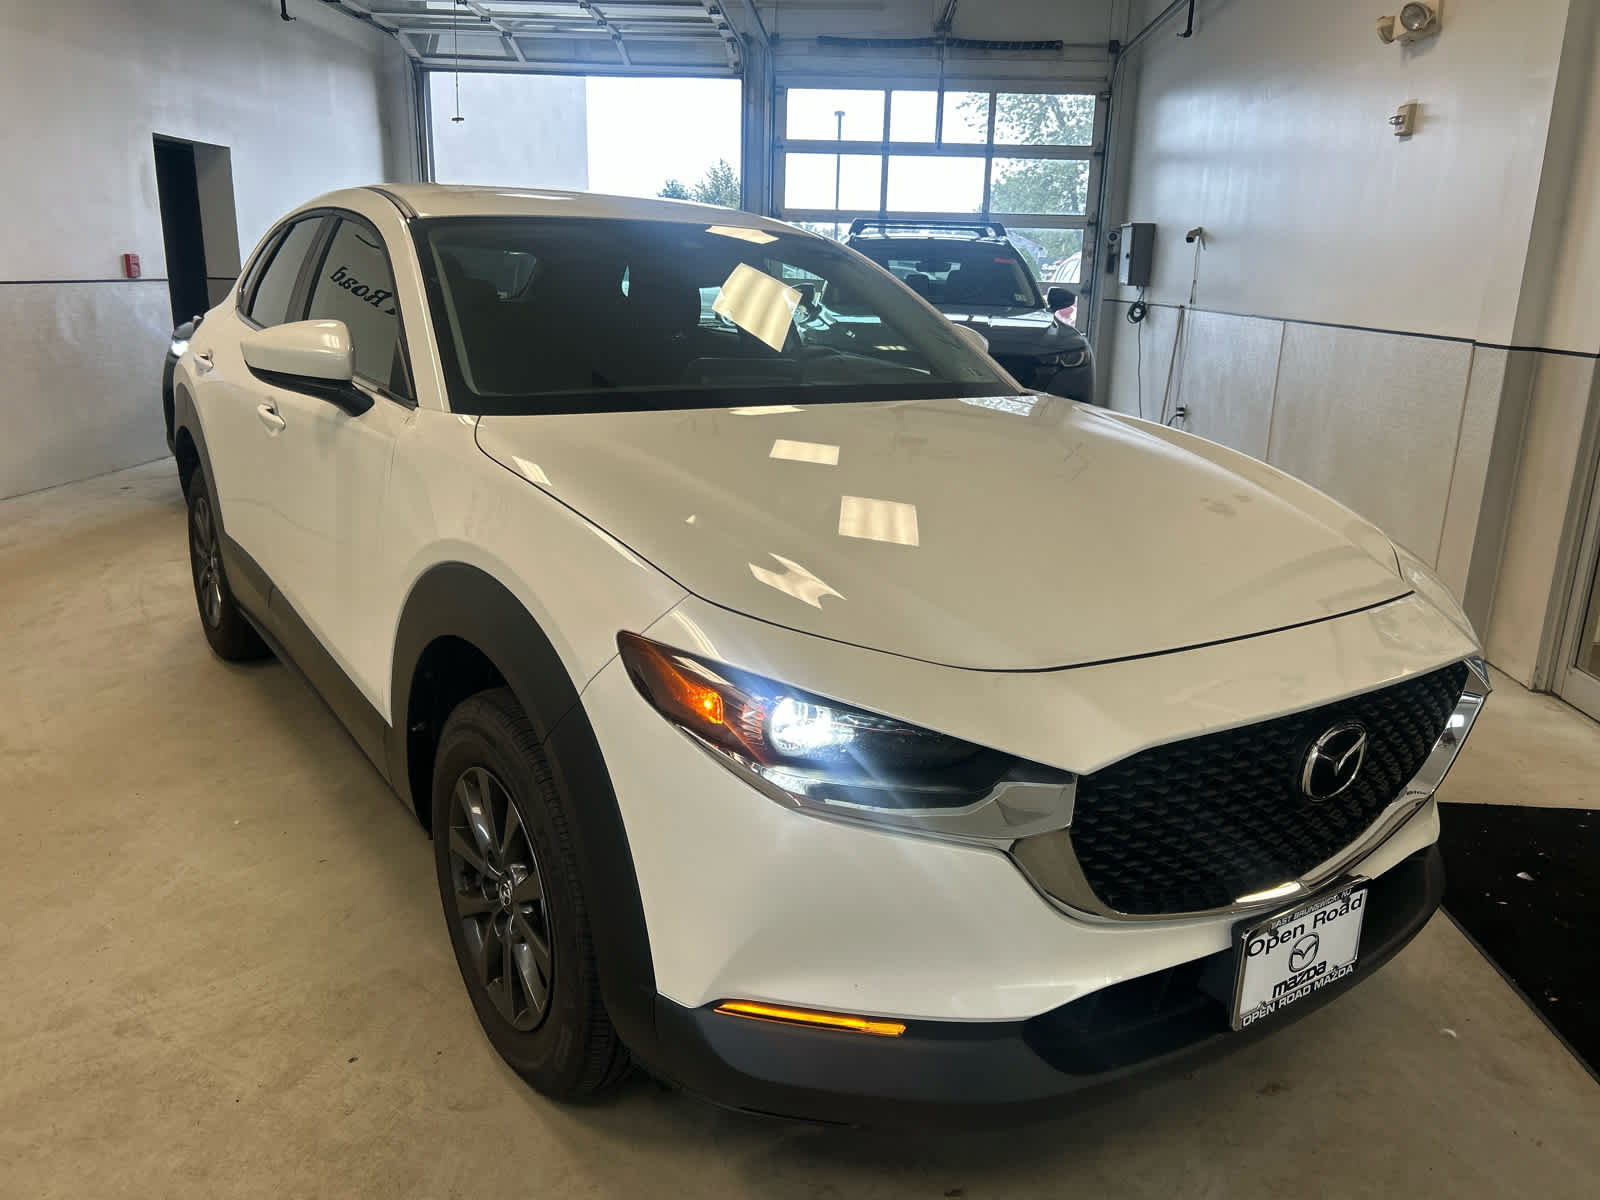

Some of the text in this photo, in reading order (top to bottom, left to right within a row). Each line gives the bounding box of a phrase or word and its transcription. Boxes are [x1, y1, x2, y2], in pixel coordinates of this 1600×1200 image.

[1246, 893, 1363, 956] Open Road
[1243, 964, 1353, 1027] OPEN ROAD MAZDA
